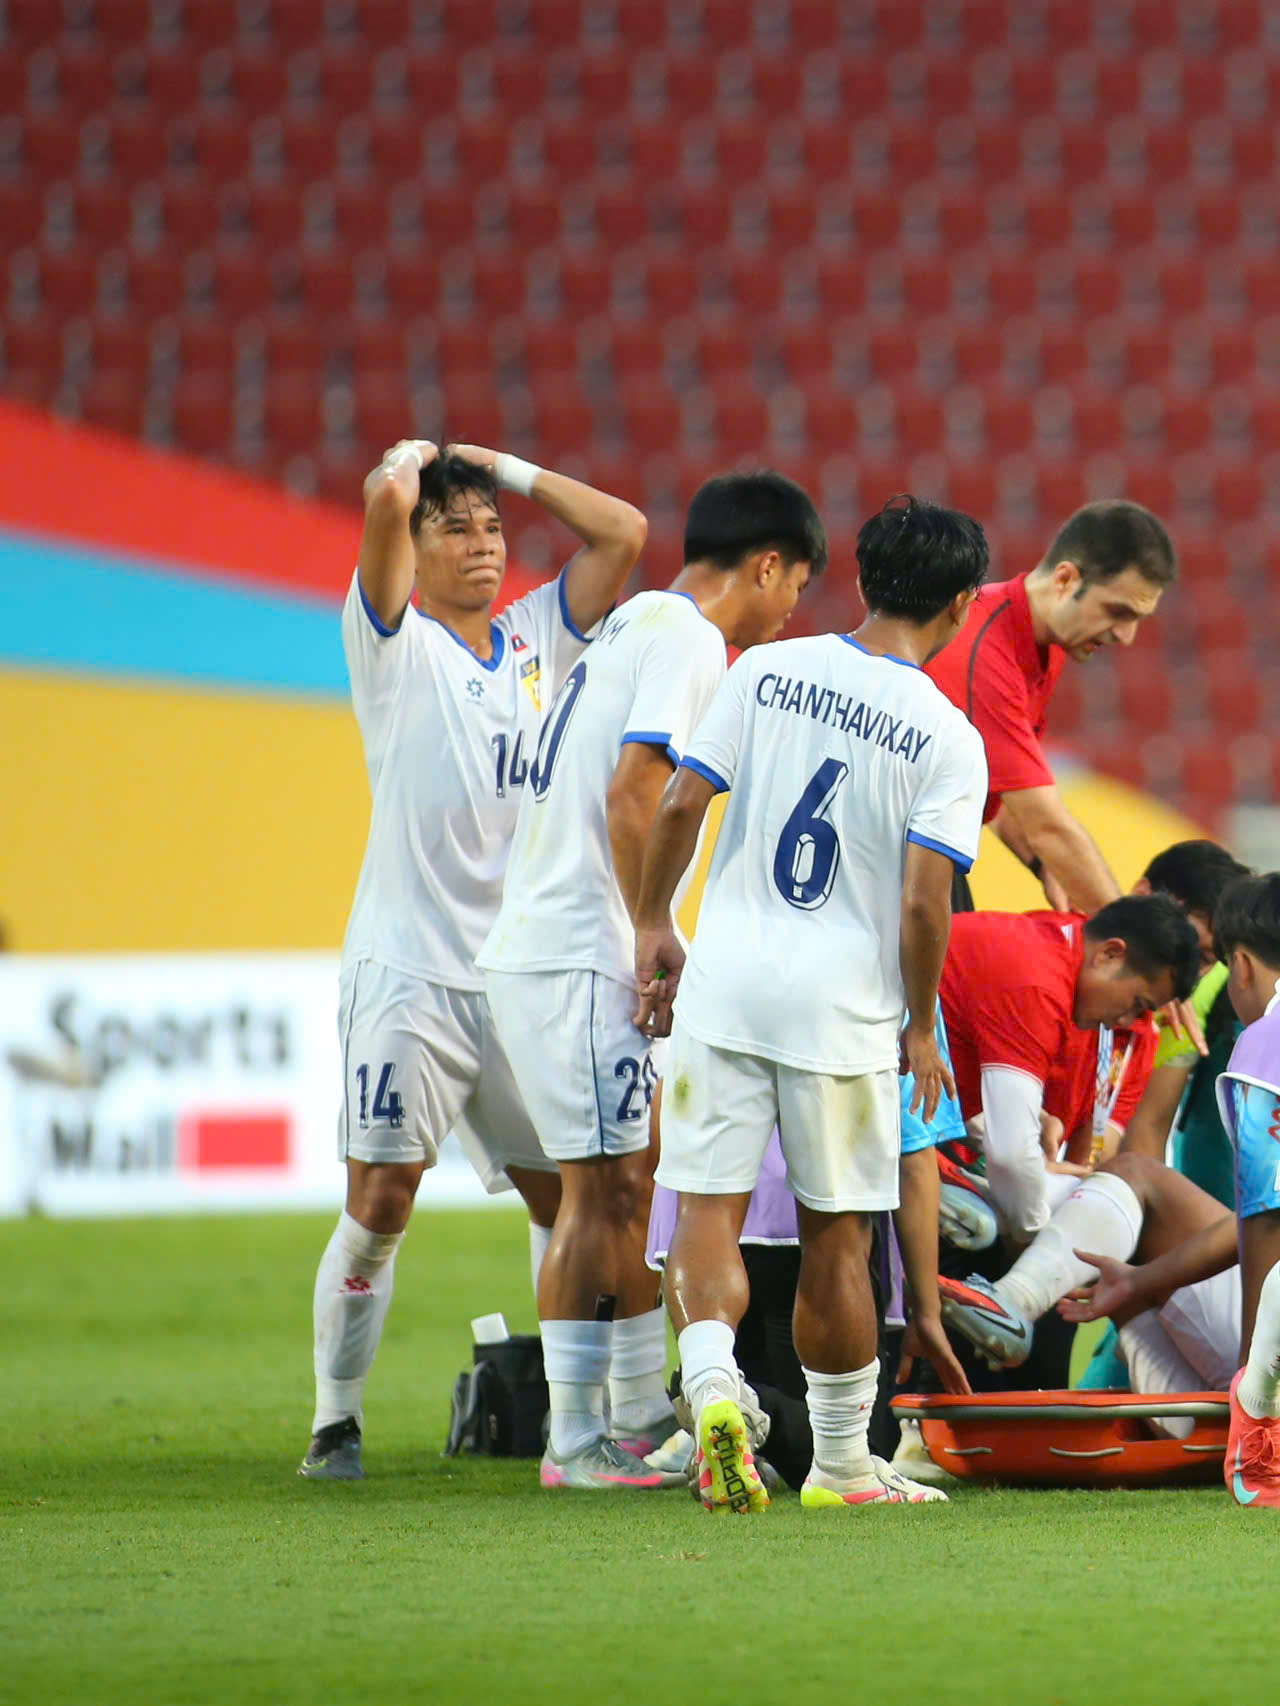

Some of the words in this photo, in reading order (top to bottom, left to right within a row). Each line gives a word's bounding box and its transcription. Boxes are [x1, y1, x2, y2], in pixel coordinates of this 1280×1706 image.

[756, 673, 932, 764] CHANTHAVIXAY
[773, 757, 849, 912] 6
[356, 1061, 406, 1130] 14
